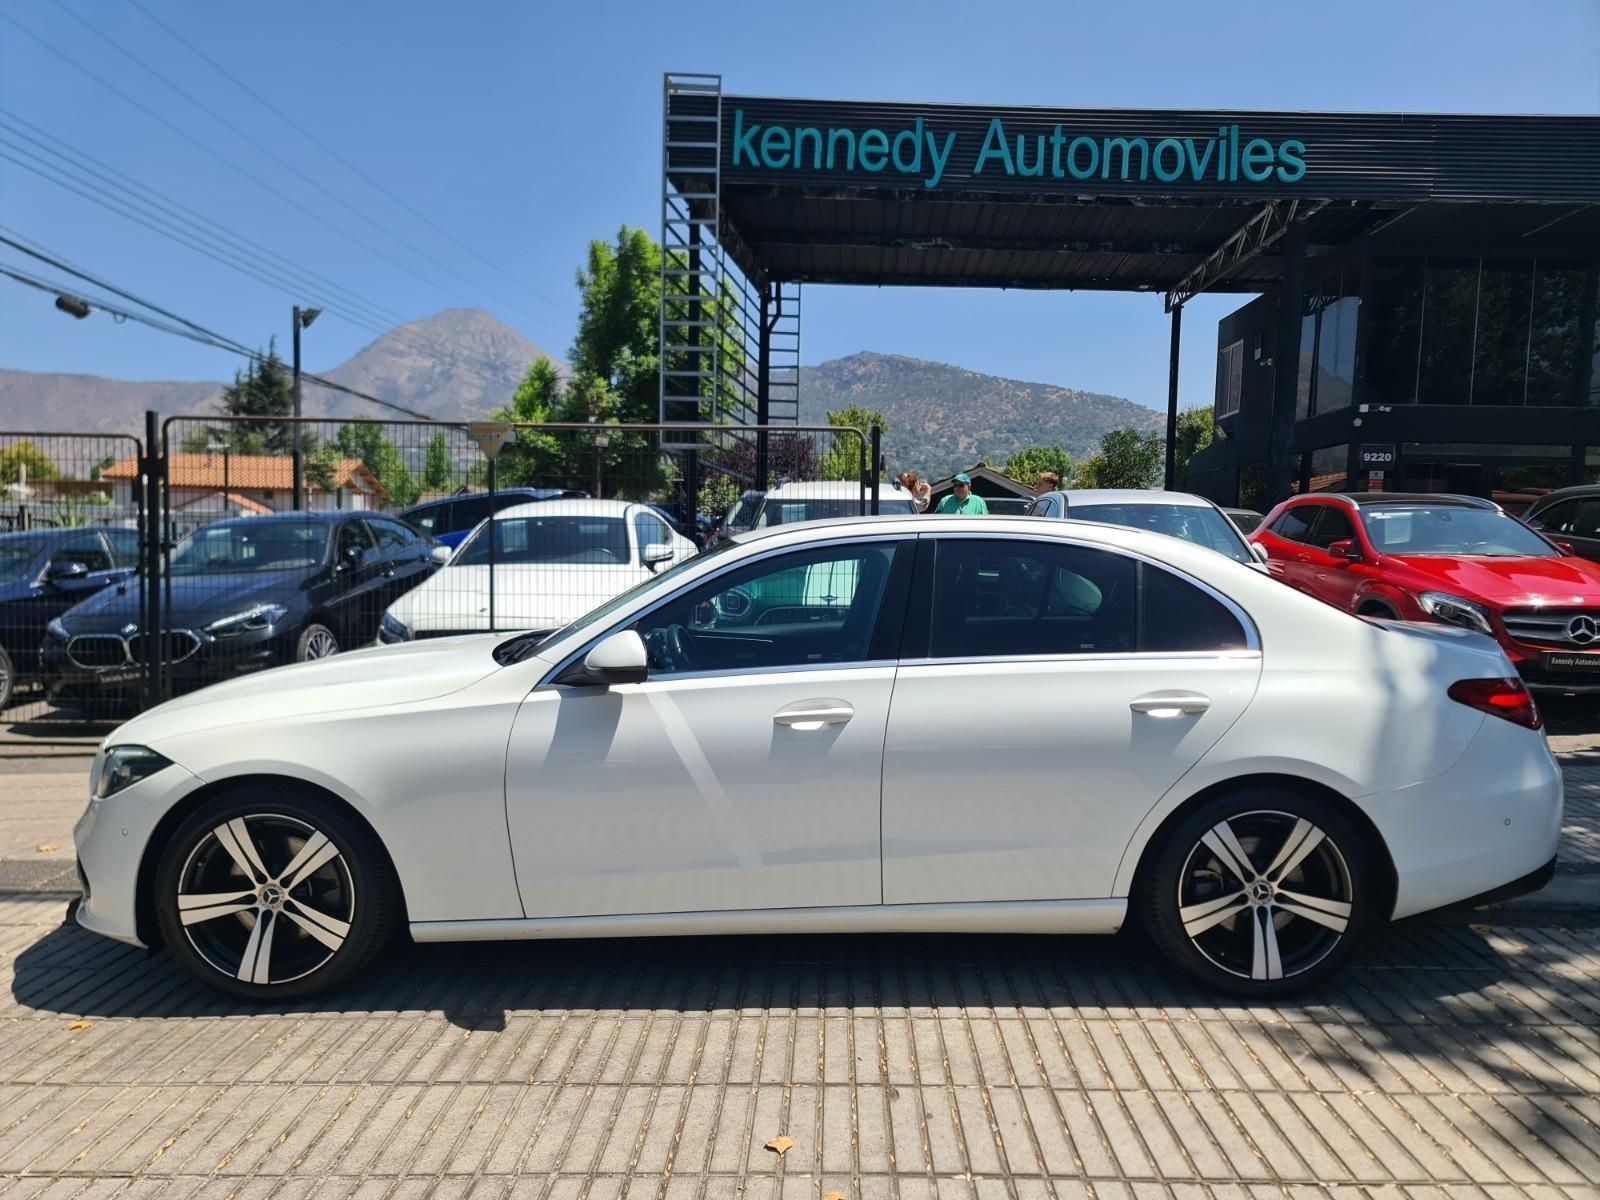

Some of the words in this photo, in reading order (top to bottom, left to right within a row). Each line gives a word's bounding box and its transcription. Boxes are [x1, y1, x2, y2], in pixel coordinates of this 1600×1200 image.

[732, 109, 956, 189] kennedy
[973, 117, 1307, 183] Automoviles
[1363, 452, 1392, 462] 9220
